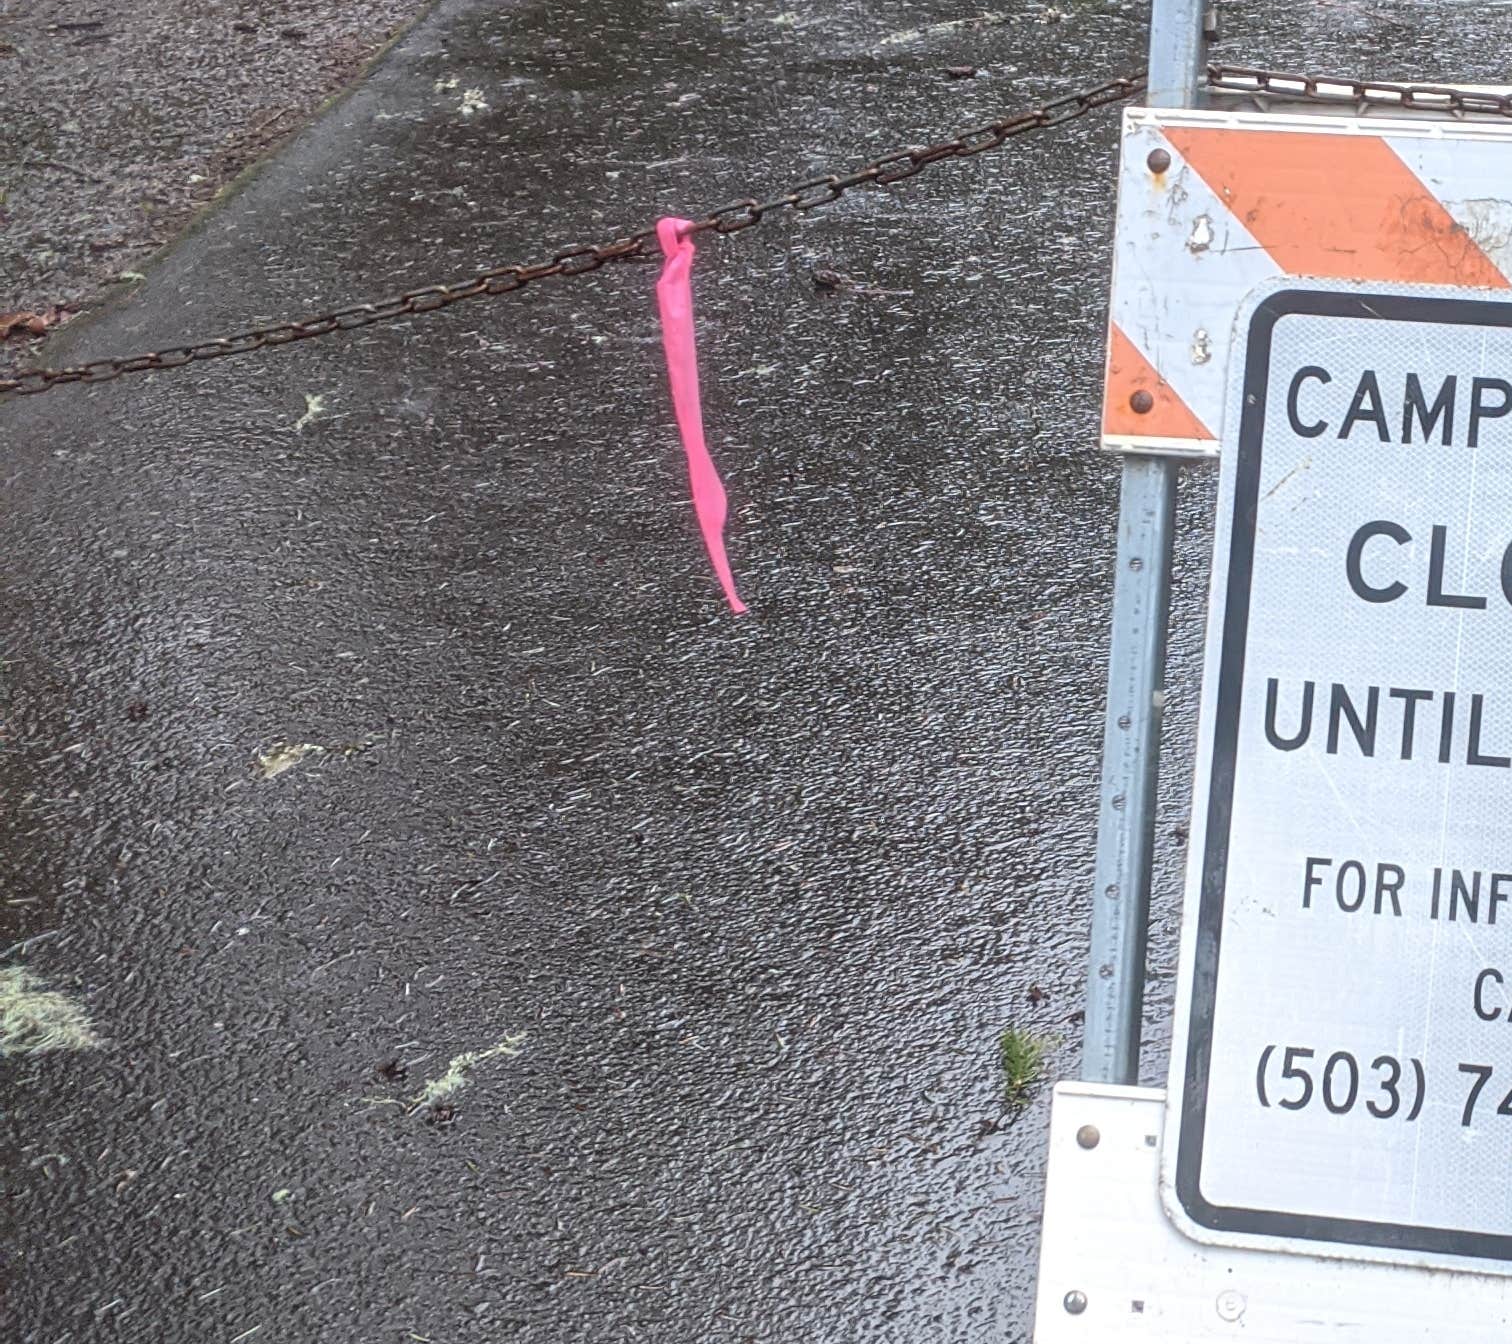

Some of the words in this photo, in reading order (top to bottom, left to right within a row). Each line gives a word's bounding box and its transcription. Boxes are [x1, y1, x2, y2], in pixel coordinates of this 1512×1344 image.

[1265, 678, 1511, 768] UNTIL
[1303, 857, 1404, 918] FOR
[1257, 1044, 1426, 1121] (503)
